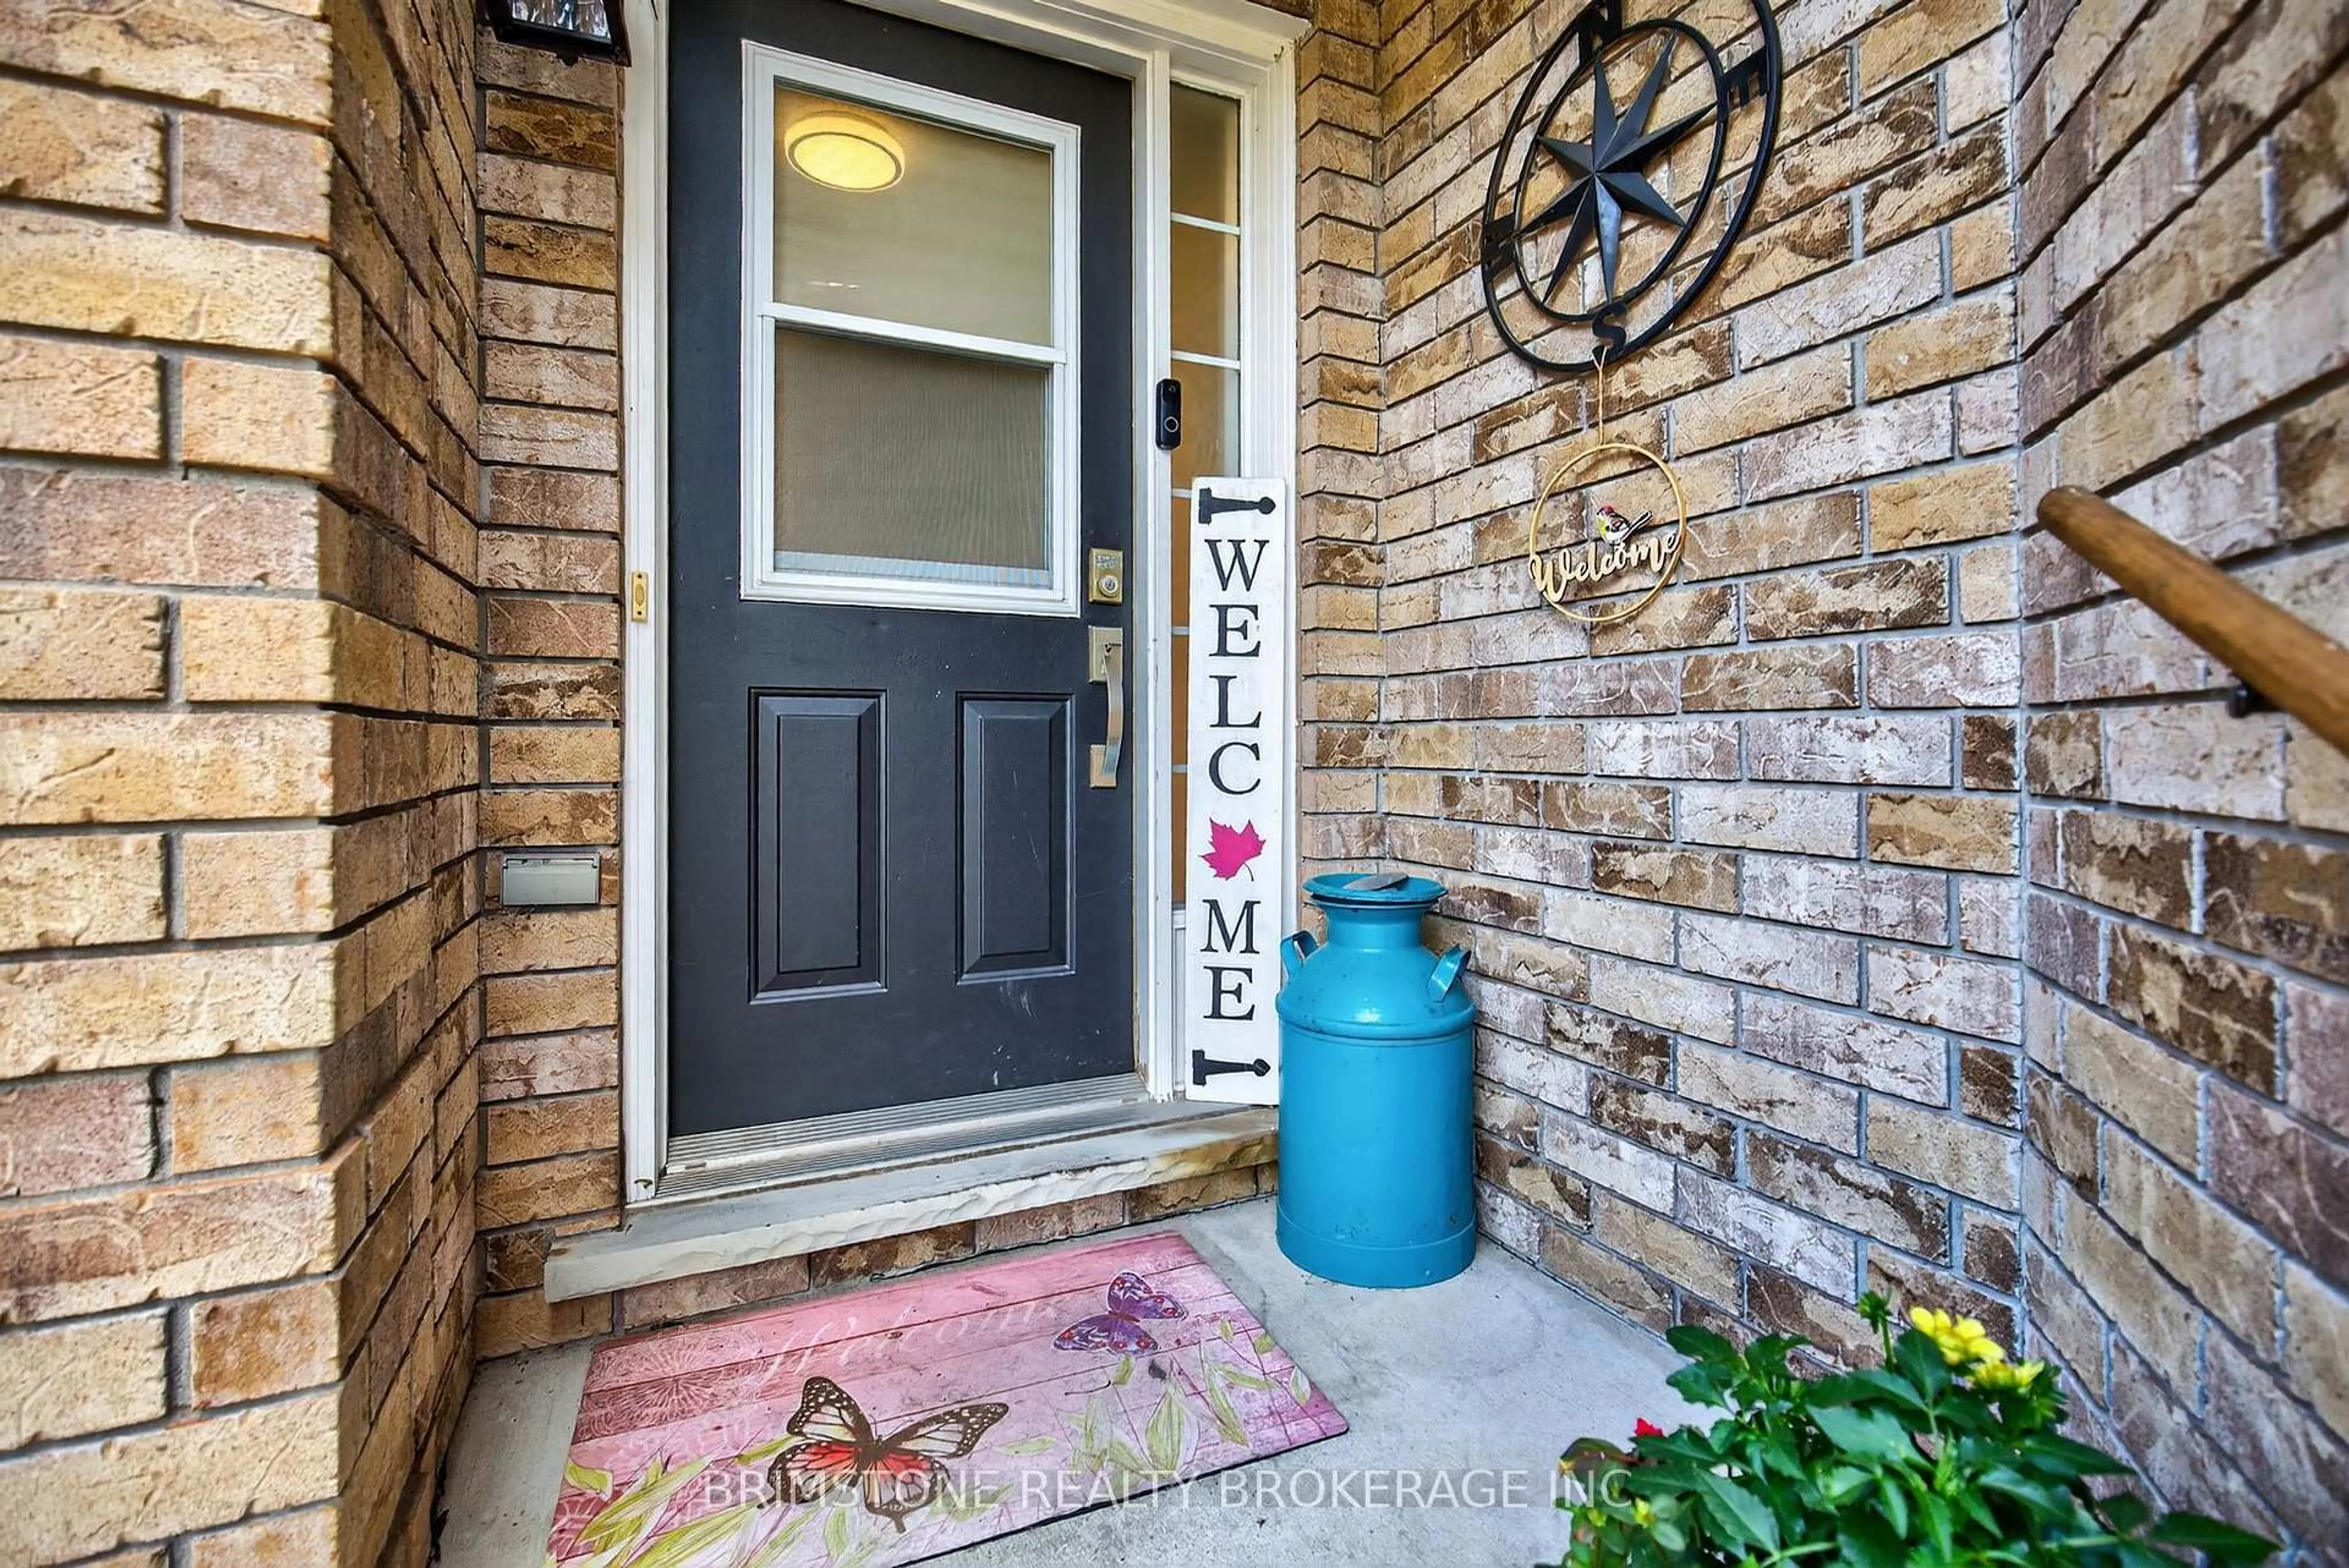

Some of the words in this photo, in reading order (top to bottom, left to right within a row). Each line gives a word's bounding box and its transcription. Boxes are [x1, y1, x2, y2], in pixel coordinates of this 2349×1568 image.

[1716, 45, 1772, 113] E
[1590, 300, 1628, 360] S
[1529, 533, 1679, 602] Welcome
[1200, 538, 1270, 1021] WELCME
